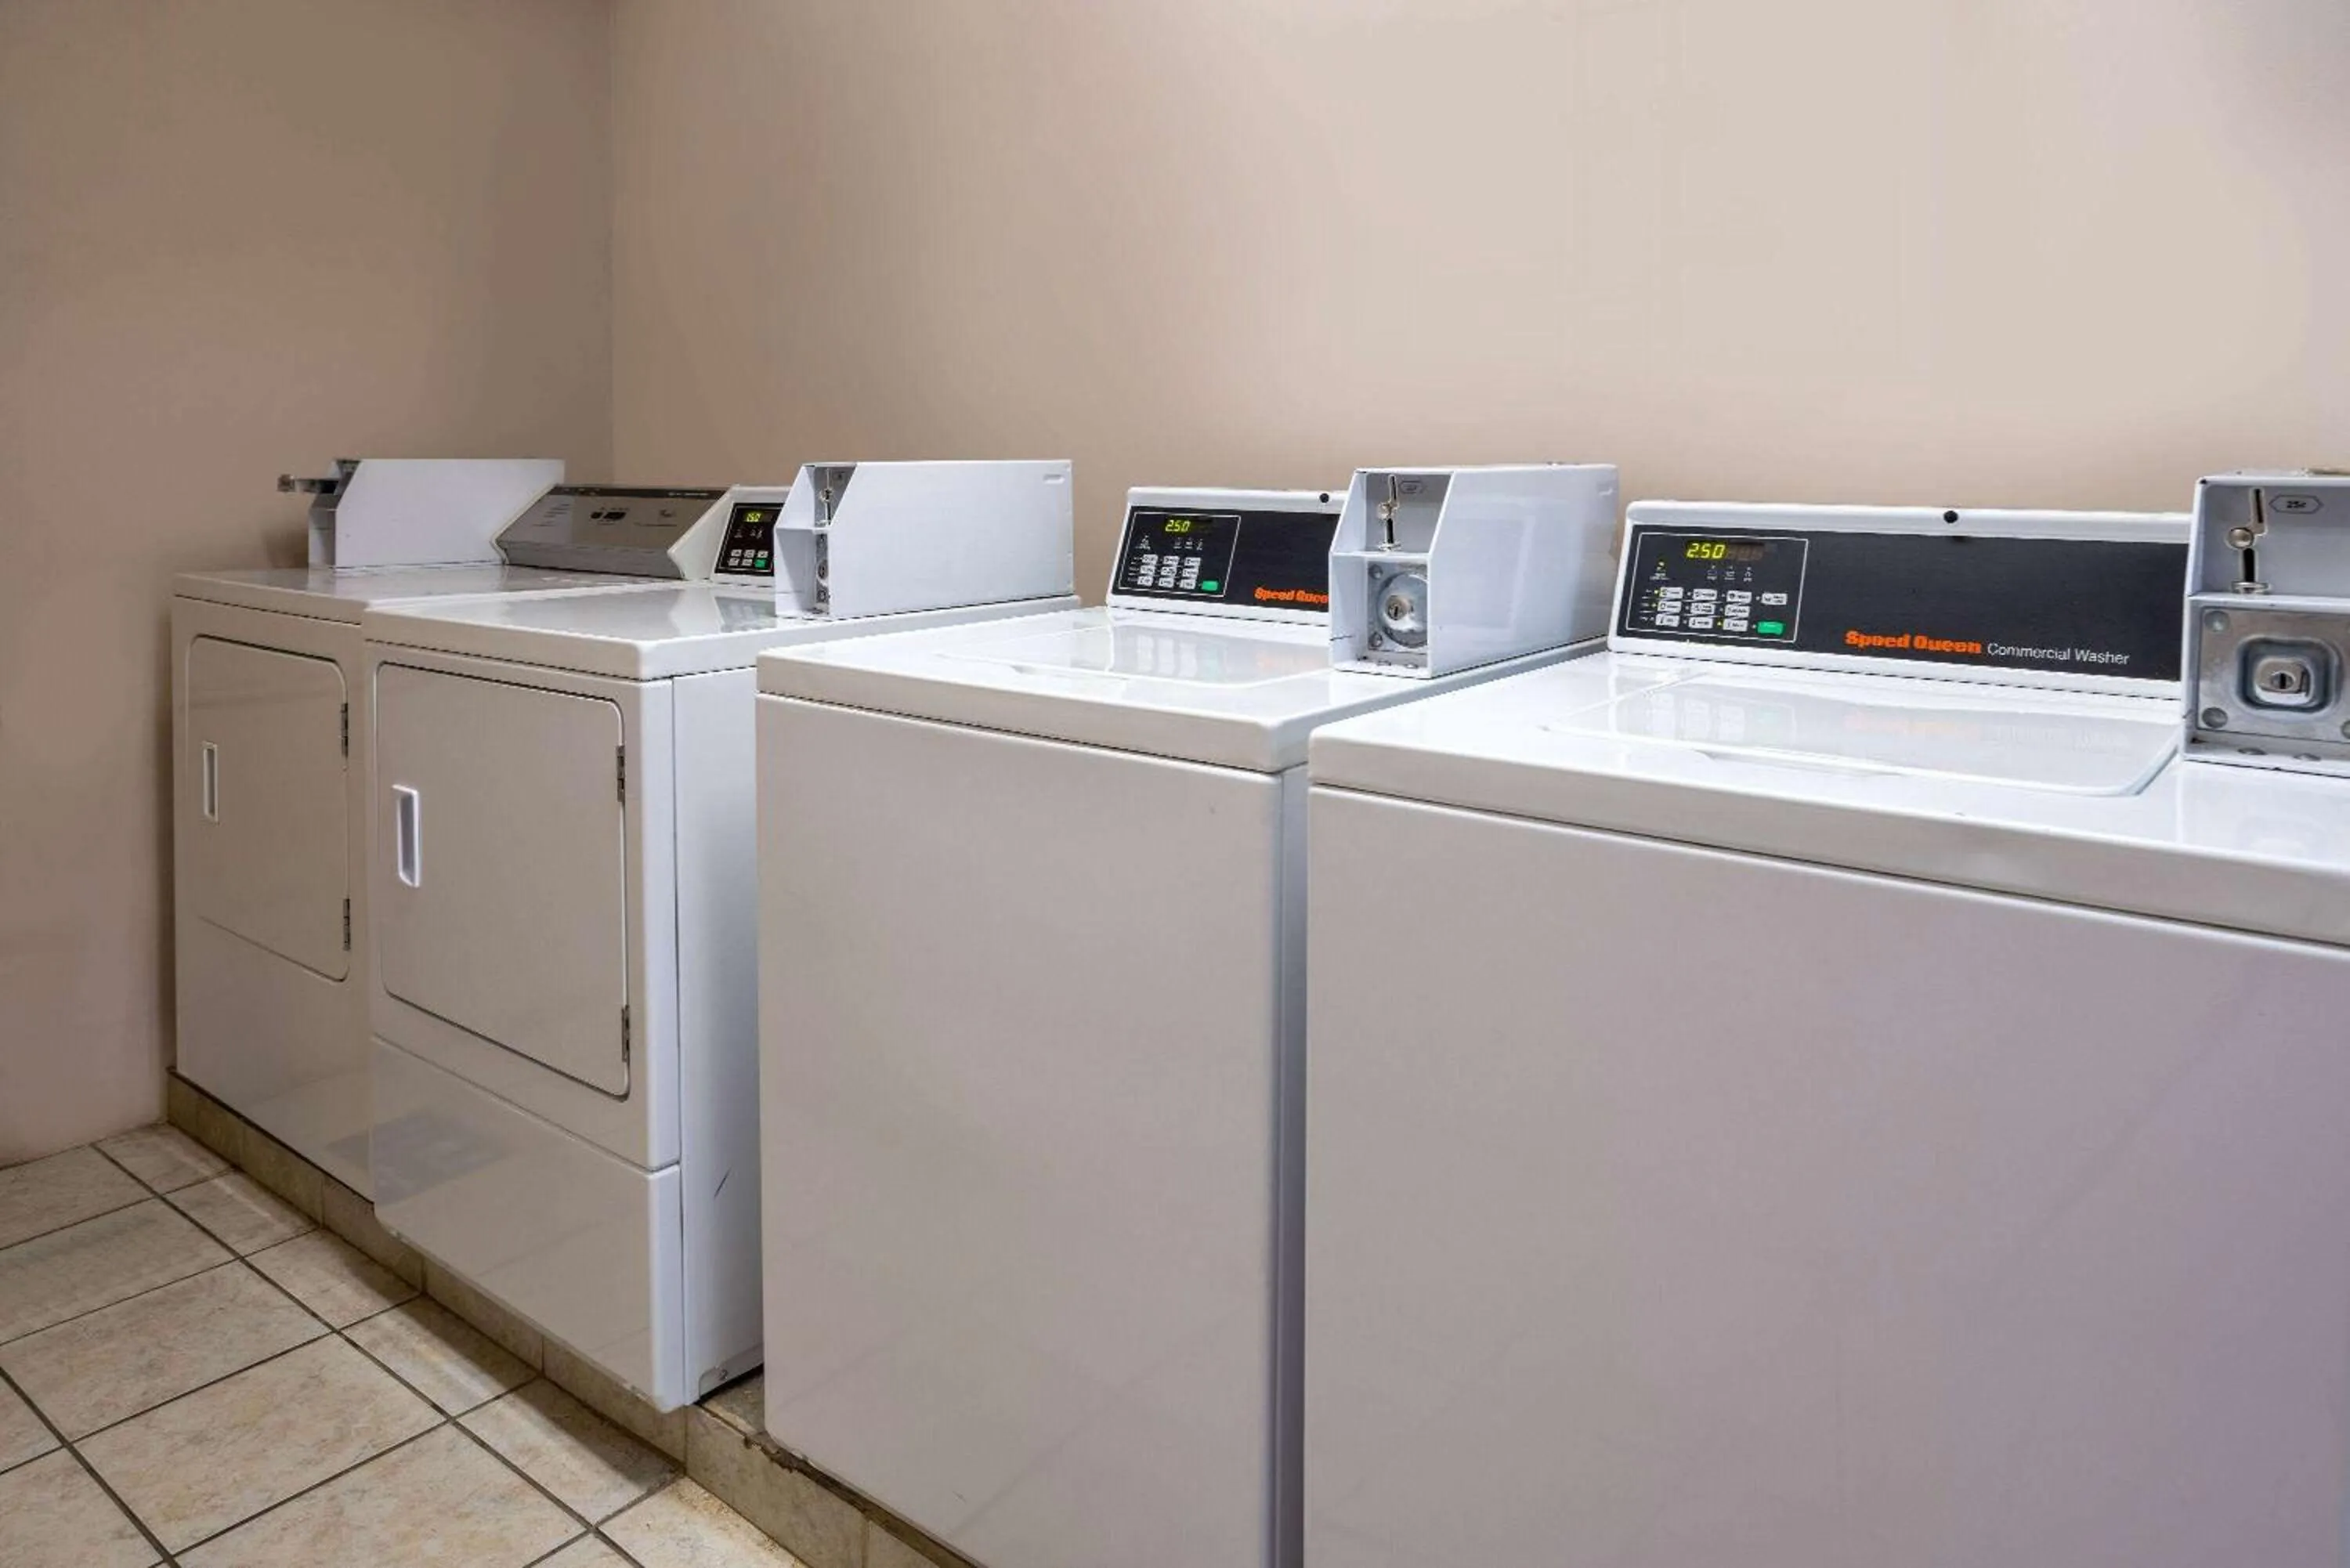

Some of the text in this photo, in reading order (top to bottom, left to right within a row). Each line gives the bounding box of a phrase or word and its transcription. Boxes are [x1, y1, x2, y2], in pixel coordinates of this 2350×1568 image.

[1255, 587, 1329, 603] Speed Quee
[1846, 630, 2131, 665] Speed Queen Commercial Washer
